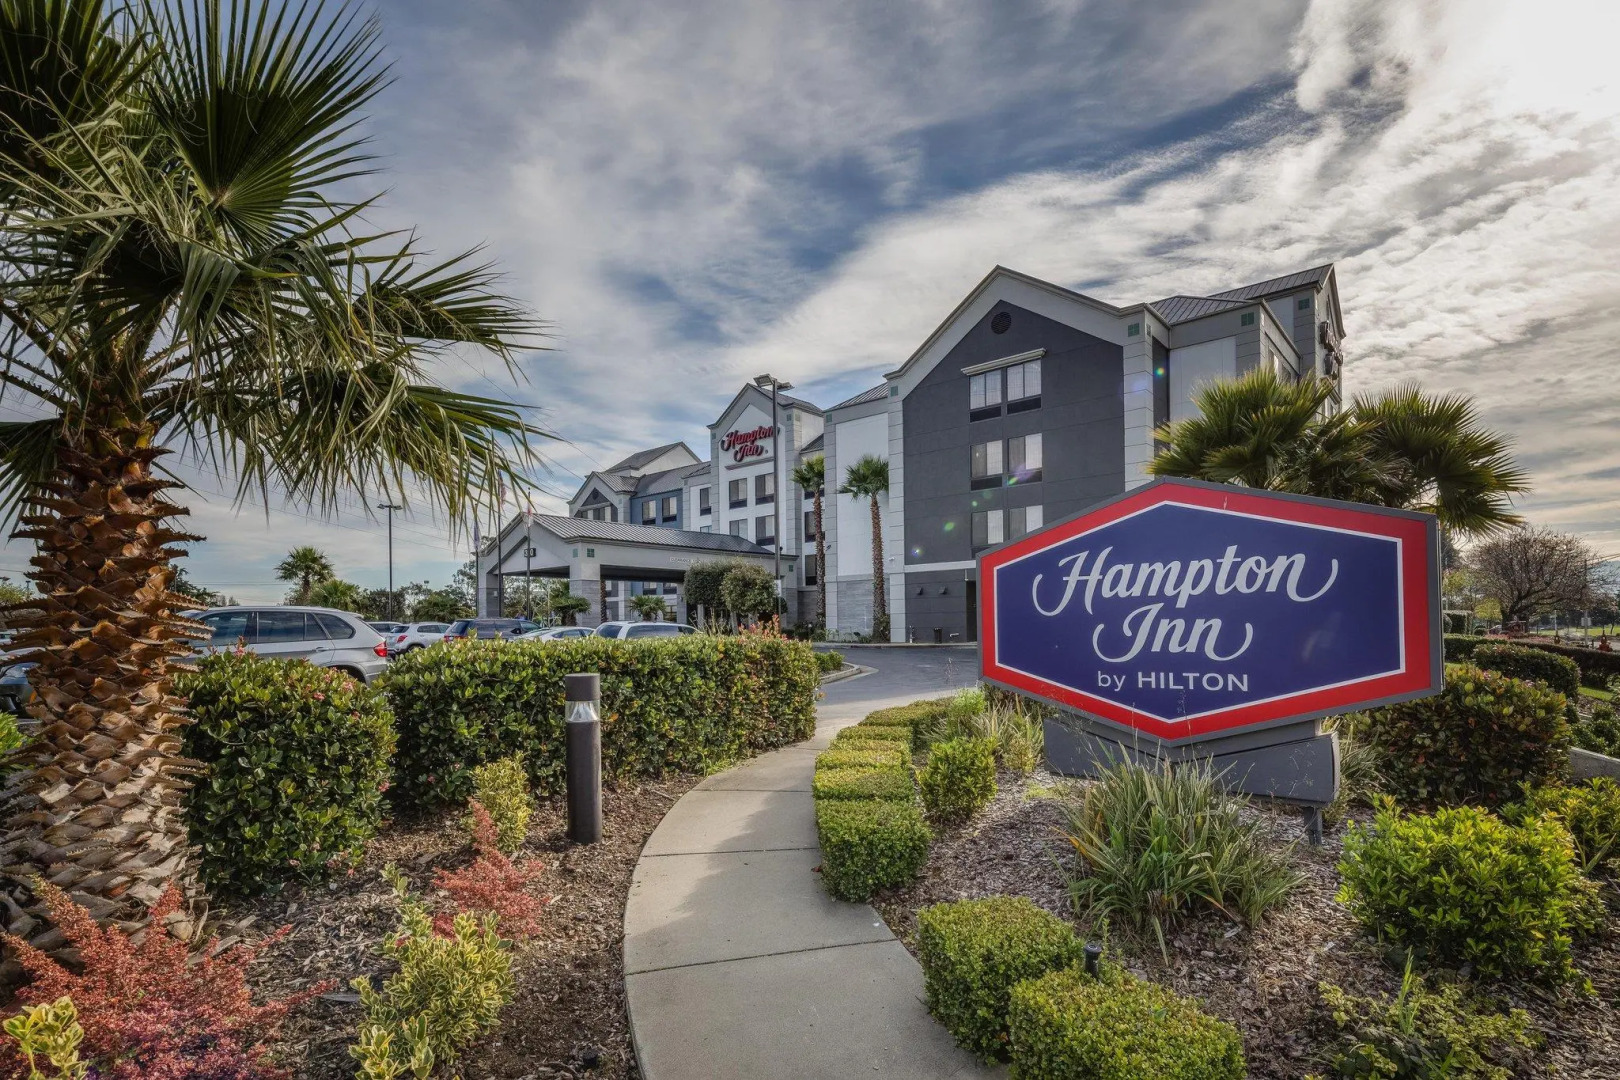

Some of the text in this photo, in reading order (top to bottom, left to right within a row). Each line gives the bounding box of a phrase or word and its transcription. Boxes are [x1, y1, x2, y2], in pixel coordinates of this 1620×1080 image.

[720, 425, 780, 451] Hampton
[733, 444, 764, 462] Inn
[1032, 544, 1339, 617] Hampton
[1092, 602, 1254, 662] Inn
[1097, 670, 1249, 692] by HILTON
